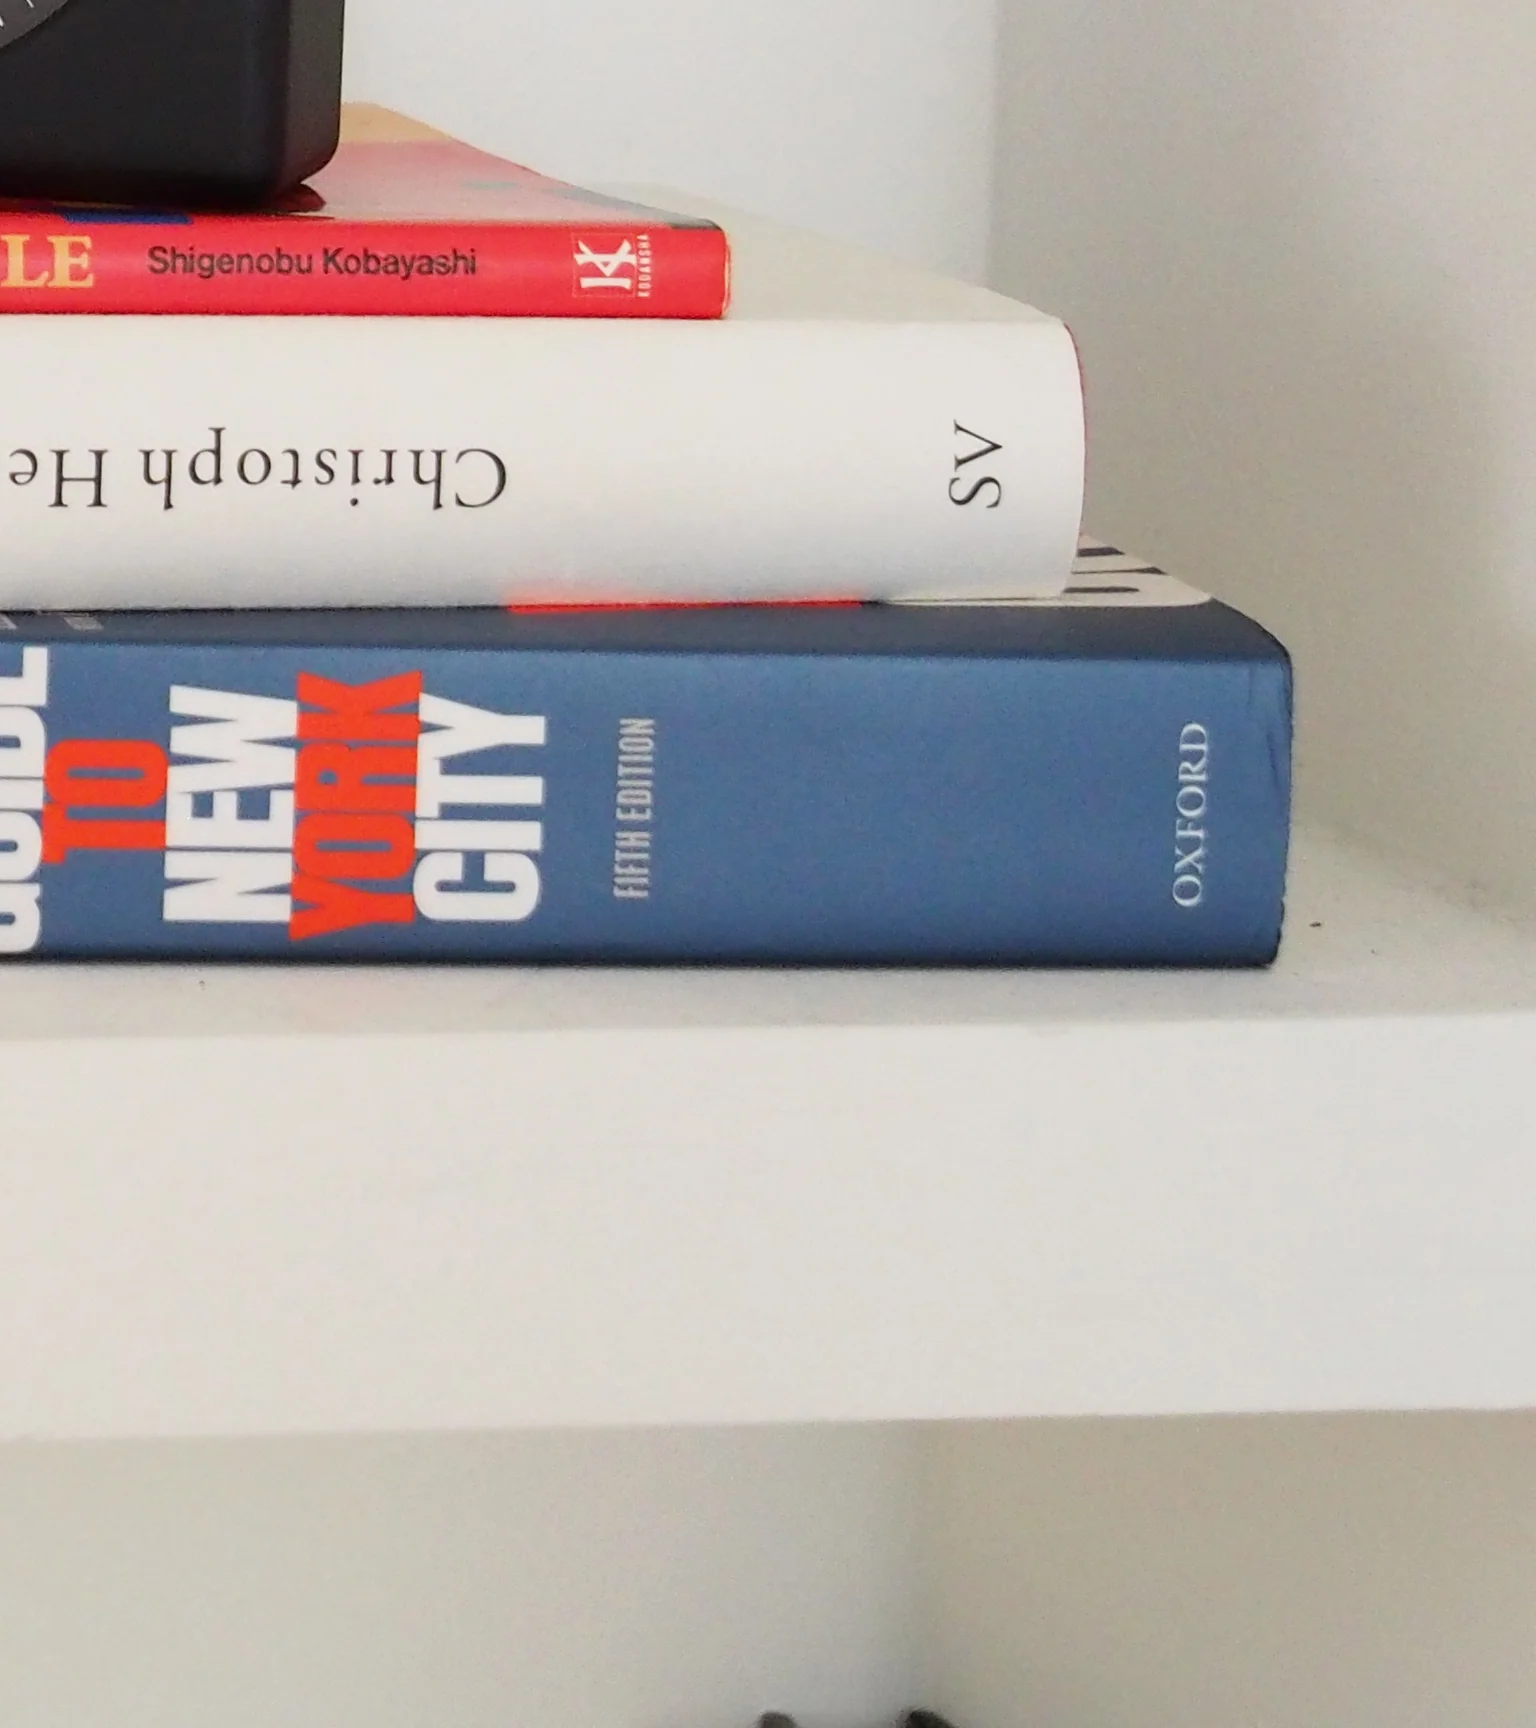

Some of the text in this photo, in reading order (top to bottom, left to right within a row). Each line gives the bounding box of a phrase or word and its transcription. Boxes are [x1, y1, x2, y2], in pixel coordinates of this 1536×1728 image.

[147, 245, 313, 280] Shigenobu
[322, 246, 478, 282] Kobayashi
[636, 233, 652, 299] KODANSHA
[137, 426, 508, 512] Christoph
[947, 418, 1004, 510] SV
[41, 738, 170, 865] TO
[163, 684, 299, 923] NEW
[288, 670, 423, 942] YORK
[412, 692, 546, 922] CITY
[612, 717, 656, 899] FIFTH EDITION
[1171, 722, 1209, 908] OXFORD
